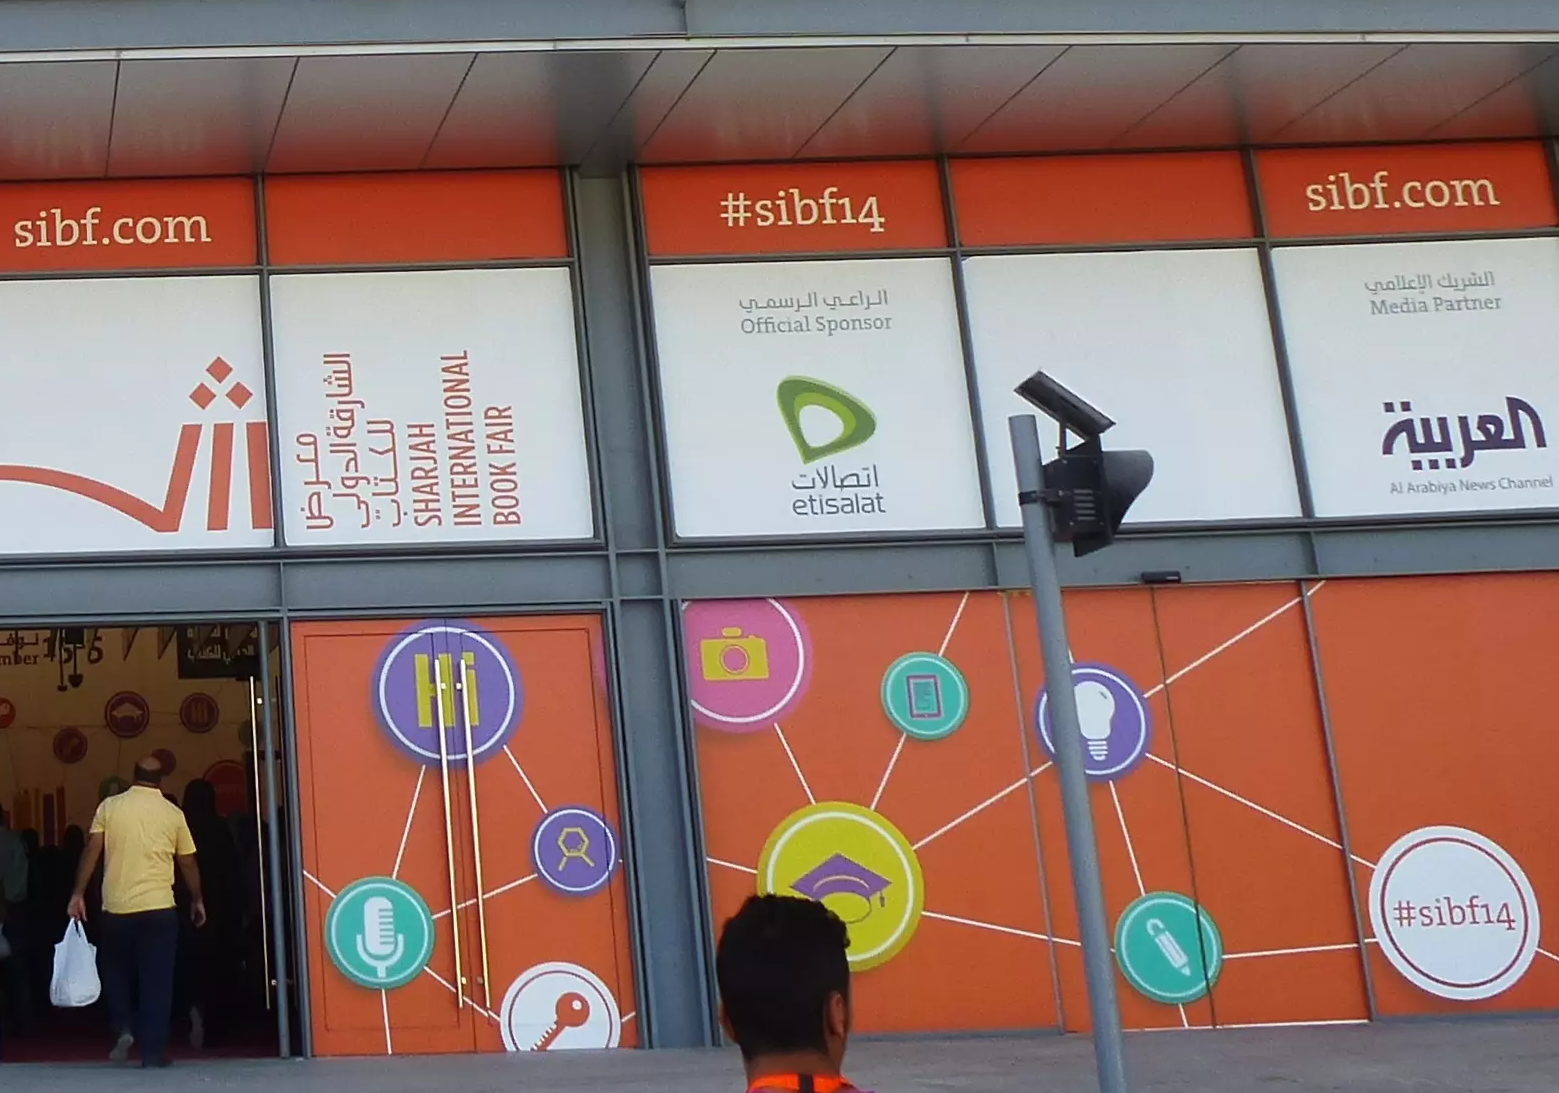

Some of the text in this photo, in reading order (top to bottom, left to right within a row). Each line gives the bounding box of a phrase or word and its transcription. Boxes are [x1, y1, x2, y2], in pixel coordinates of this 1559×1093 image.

[720, 187, 886, 232] #sibf14
[1306, 171, 1501, 211] sibf.com
[14, 207, 212, 247] sibf.com
[1437, 271, 1495, 291] الشريك
[739, 289, 888, 313] الراعي الرسمي
[1370, 296, 1501, 315] Media Partner
[741, 315, 892, 336] Official Sponsor
[440, 350, 482, 526] INTERNATIONAL
[1382, 395, 1547, 471] العربية
[406, 423, 442, 527] SHARJAH
[484, 405, 521, 526] BOOK FAIR
[791, 464, 880, 492] اتصالات
[792, 492, 886, 516] etisalat
[1390, 476, 1554, 495] Al Arabiya News Channel
[413, 651, 480, 728] Hi
[1392, 895, 1517, 932] #sibf14
